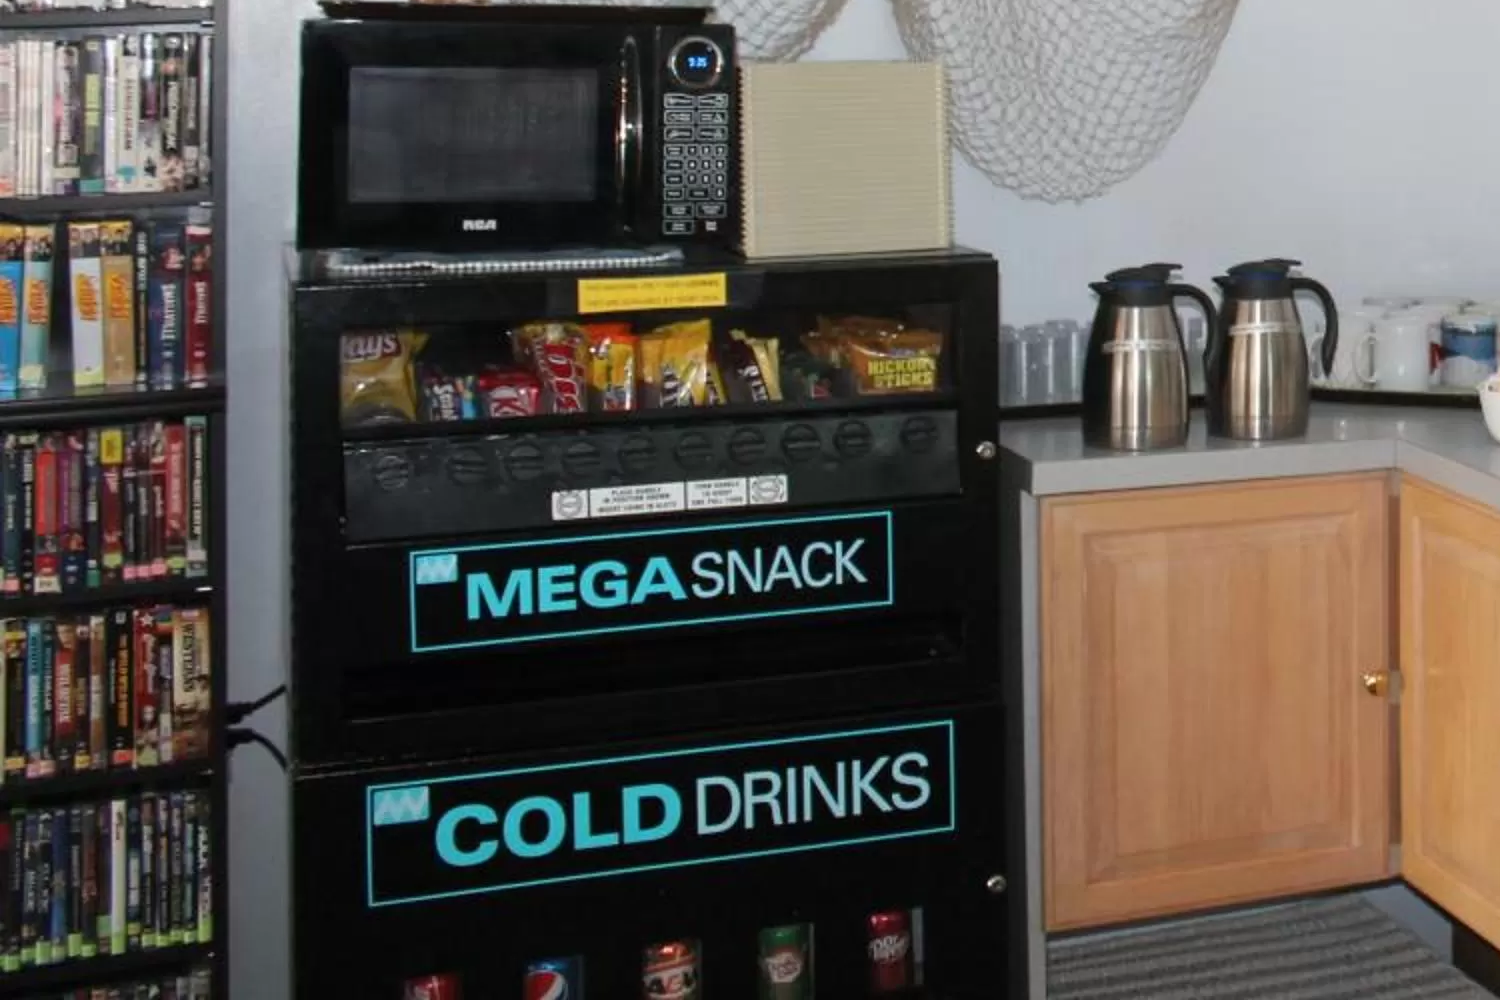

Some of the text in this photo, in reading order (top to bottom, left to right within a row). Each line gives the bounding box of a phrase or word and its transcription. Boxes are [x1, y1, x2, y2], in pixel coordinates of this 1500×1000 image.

[462, 218, 498, 231] RCA
[867, 357, 937, 376] HICKORY
[465, 538, 868, 621] MEGA SNACK
[434, 751, 931, 868] COLD DRINKS
